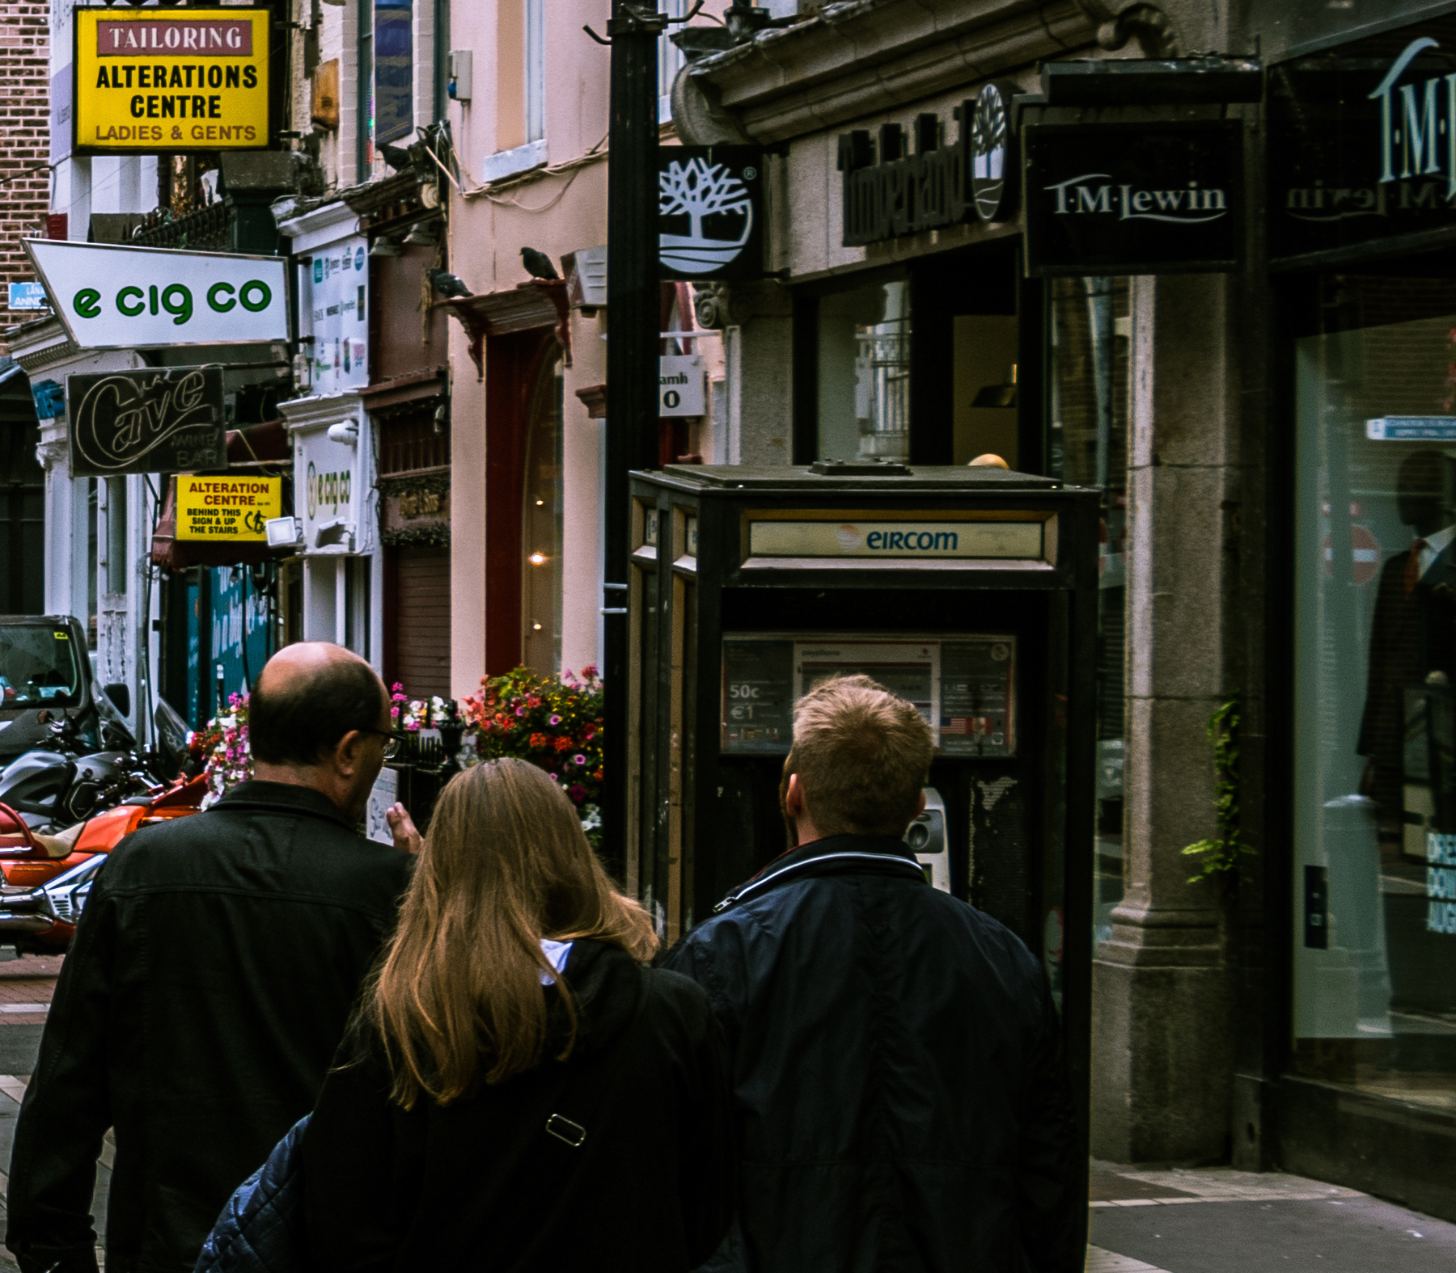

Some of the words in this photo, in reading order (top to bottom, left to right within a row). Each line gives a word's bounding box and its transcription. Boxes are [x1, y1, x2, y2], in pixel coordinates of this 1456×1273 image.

[109, 27, 242, 50] TAILORING
[96, 65, 258, 89] ALTERATIONS
[130, 95, 222, 119] CENTRE
[95, 125, 163, 141] LADIES
[170, 125, 183, 140] &
[191, 125, 257, 141] GENTS
[73, 287, 102, 319] e
[207, 279, 272, 313] co
[176, 450, 218, 467] BAR
[189, 482, 270, 494] ALTERATION
[204, 495, 256, 506] CENTRE
[187, 508, 220, 516] BEHIND
[221, 508, 241, 516] THIS
[192, 517, 214, 525] SIGN
[215, 517, 221, 525] &
[224, 517, 236, 525] UP
[189, 526, 207, 534] THE
[208, 526, 239, 534] STAIRS
[730, 684, 760, 699] 50c
